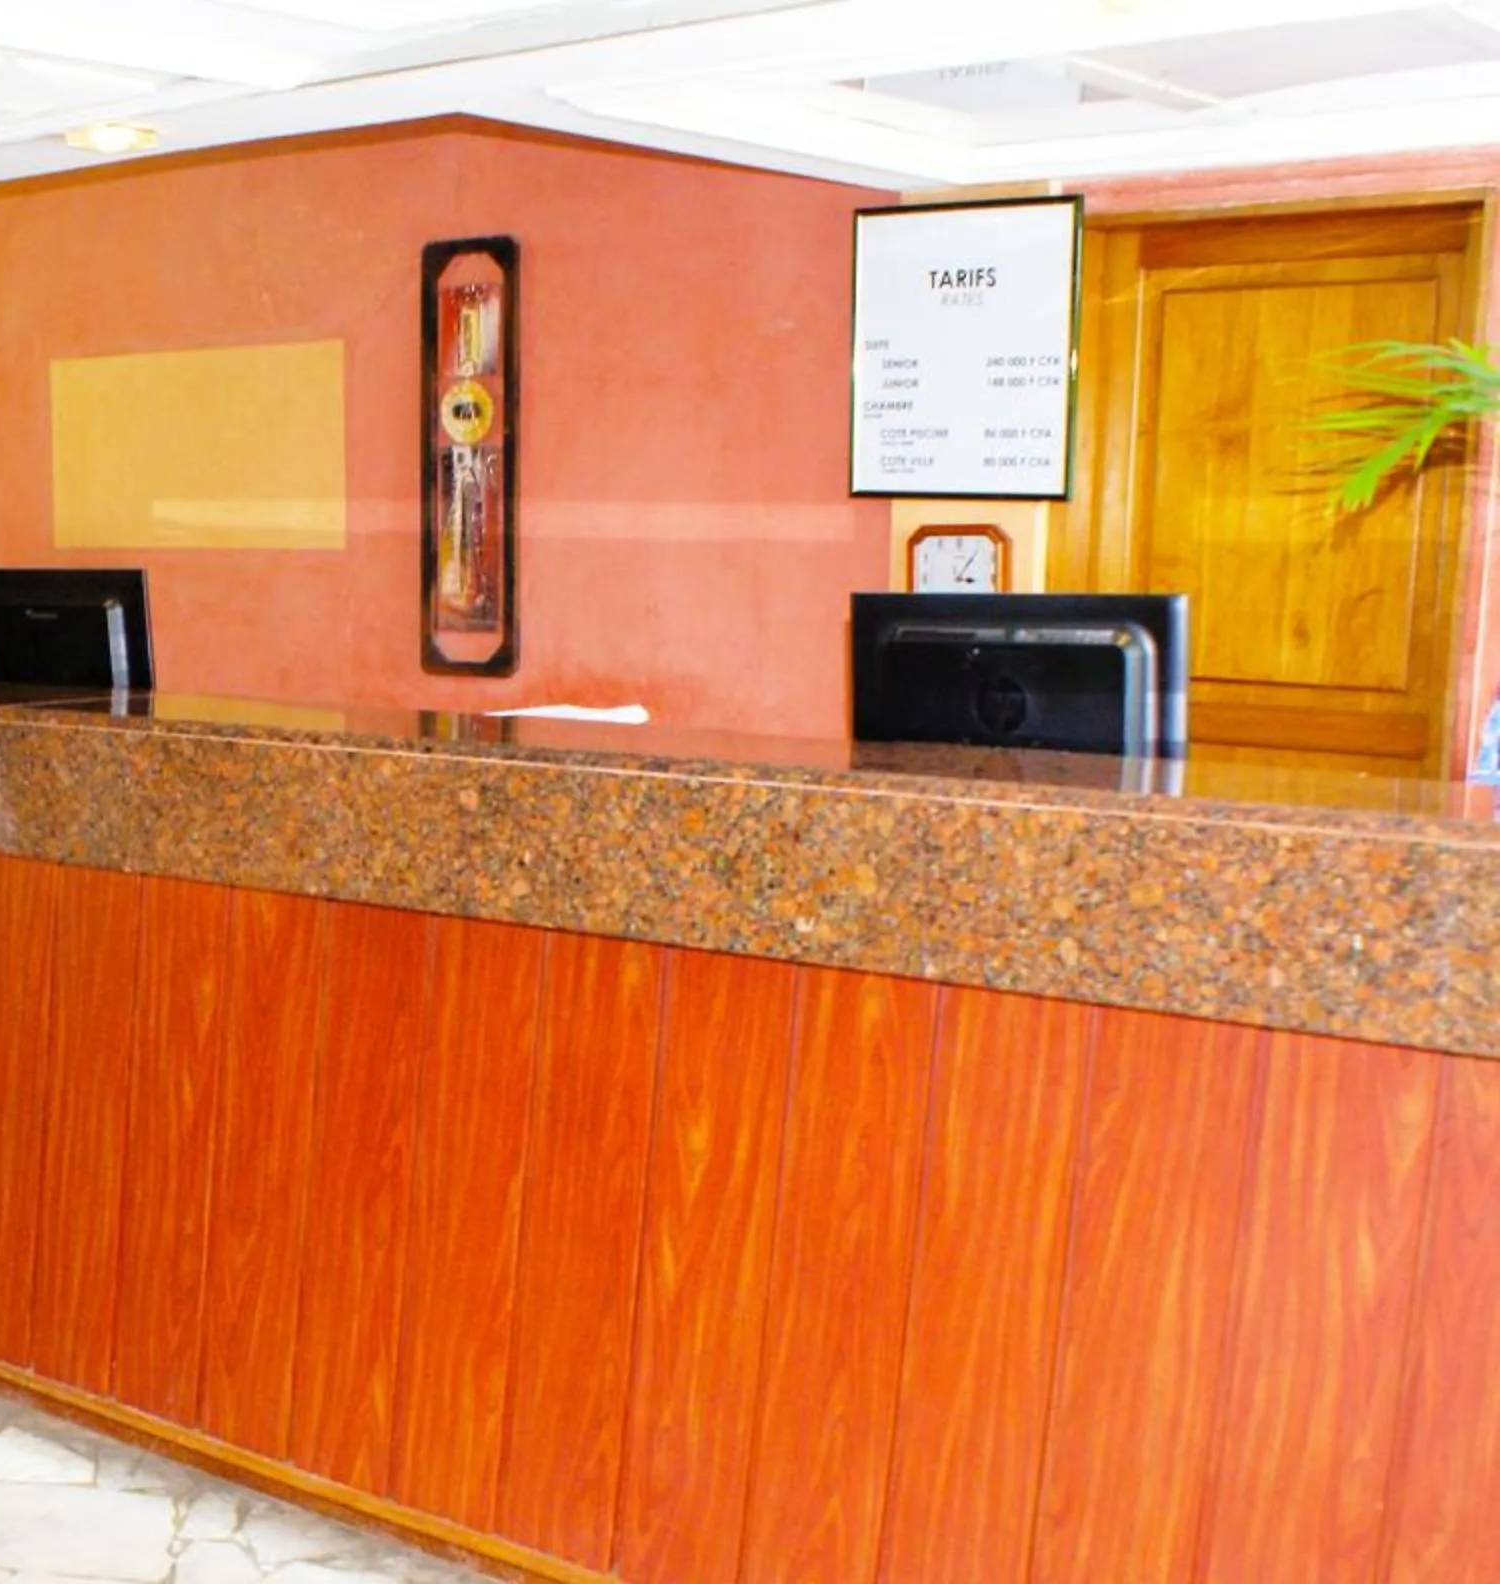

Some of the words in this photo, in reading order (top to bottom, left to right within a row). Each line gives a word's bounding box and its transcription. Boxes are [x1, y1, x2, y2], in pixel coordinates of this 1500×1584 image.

[928, 266, 997, 289] TARIFS
[940, 291, 984, 307] RATES
[882, 358, 919, 370] SENIOR
[1038, 355, 1060, 366] CFA
[882, 377, 919, 389] JUNIOR
[863, 399, 914, 412] CHAMBRE
